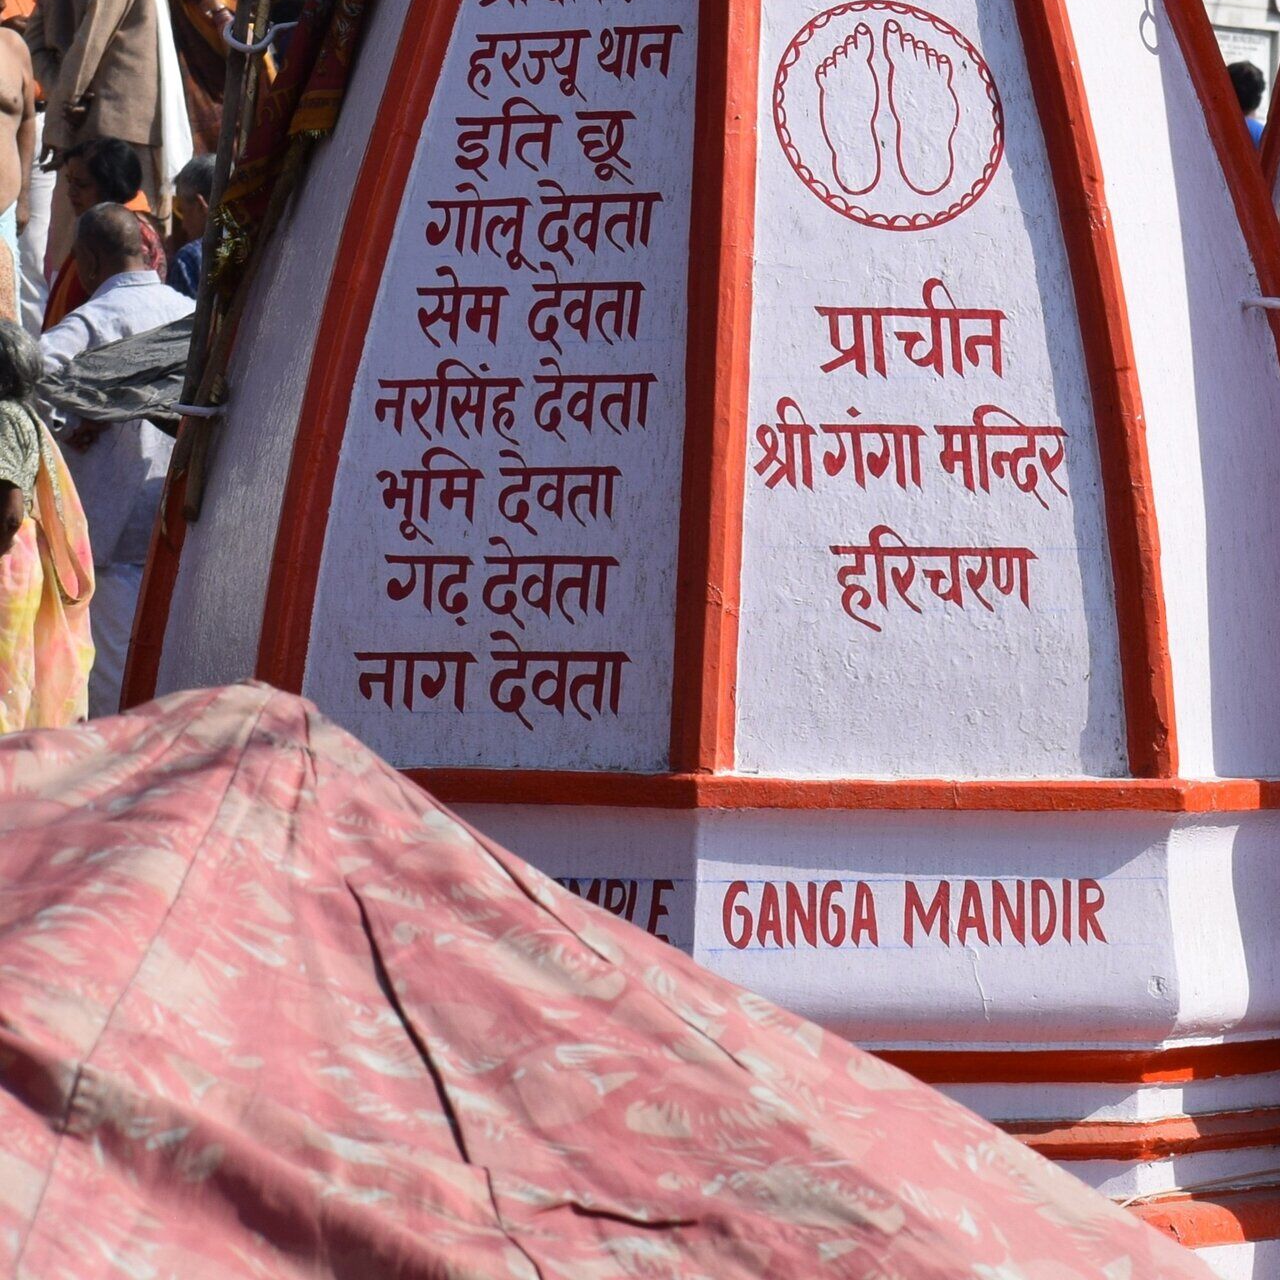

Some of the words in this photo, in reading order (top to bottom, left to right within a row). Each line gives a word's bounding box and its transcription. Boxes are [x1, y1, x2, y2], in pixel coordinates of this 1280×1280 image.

[467, 29, 593, 103] हरज्यू
[597, 24, 684, 81] थान
[455, 96, 564, 181] इति
[575, 110, 637, 185] छू
[425, 182, 540, 273] गोलू
[537, 179, 664, 267] देवता
[416, 266, 510, 348] सेम
[527, 261, 647, 355] देवता
[813, 277, 1009, 380] प्राचीन
[374, 358, 525, 446] नरसिंह
[533, 356, 659, 443] देवता
[376, 446, 486, 545] भूमि
[498, 449, 623, 536] देवता
[753, 396, 818, 492] श्री
[819, 406, 929, 492] गंगा
[933, 404, 1070, 510] मन्दिर
[384, 554, 475, 627] गढ़
[482, 536, 621, 631] देवता
[829, 524, 1040, 632] हरिचरण
[353, 651, 480, 714] नाग
[490, 630, 634, 731] देवता
[722, 880, 879, 950] GANGA
[902, 878, 1110, 950] MANDIR
